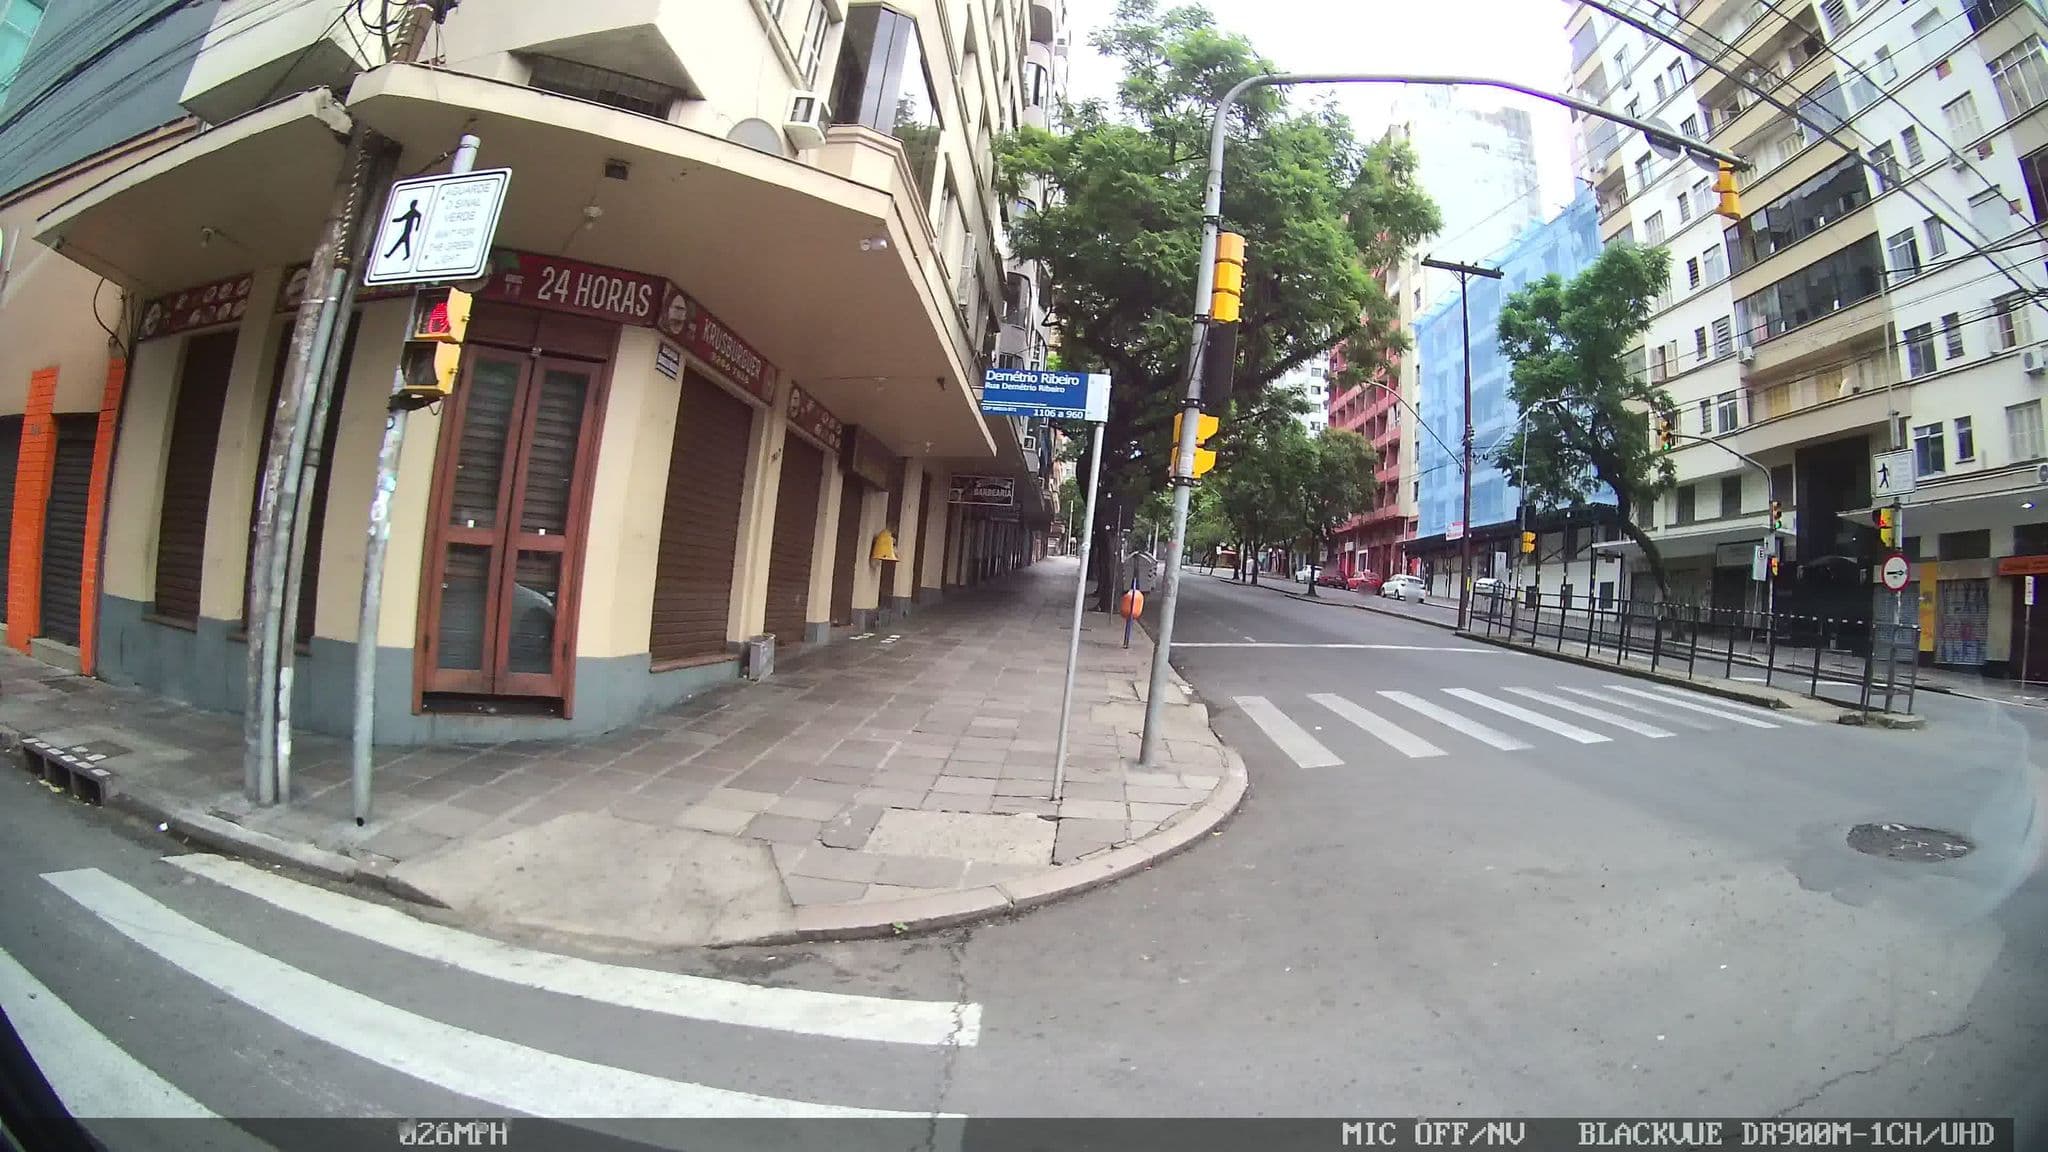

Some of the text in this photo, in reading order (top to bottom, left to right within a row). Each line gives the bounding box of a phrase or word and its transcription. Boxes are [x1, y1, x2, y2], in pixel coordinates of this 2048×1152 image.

[445, 182, 492, 196] AGUARDE
[456, 199, 481, 209] SINAL
[445, 211, 476, 223] VERDE
[538, 266, 652, 317] 24 HORAS
[985, 370, 1080, 386] Demétrio Ribeiro
[985, 382, 1065, 393] Rua Demétrio Ribeiro
[1033, 409, 1056, 417] 1106
[1065, 411, 1083, 419] 960
